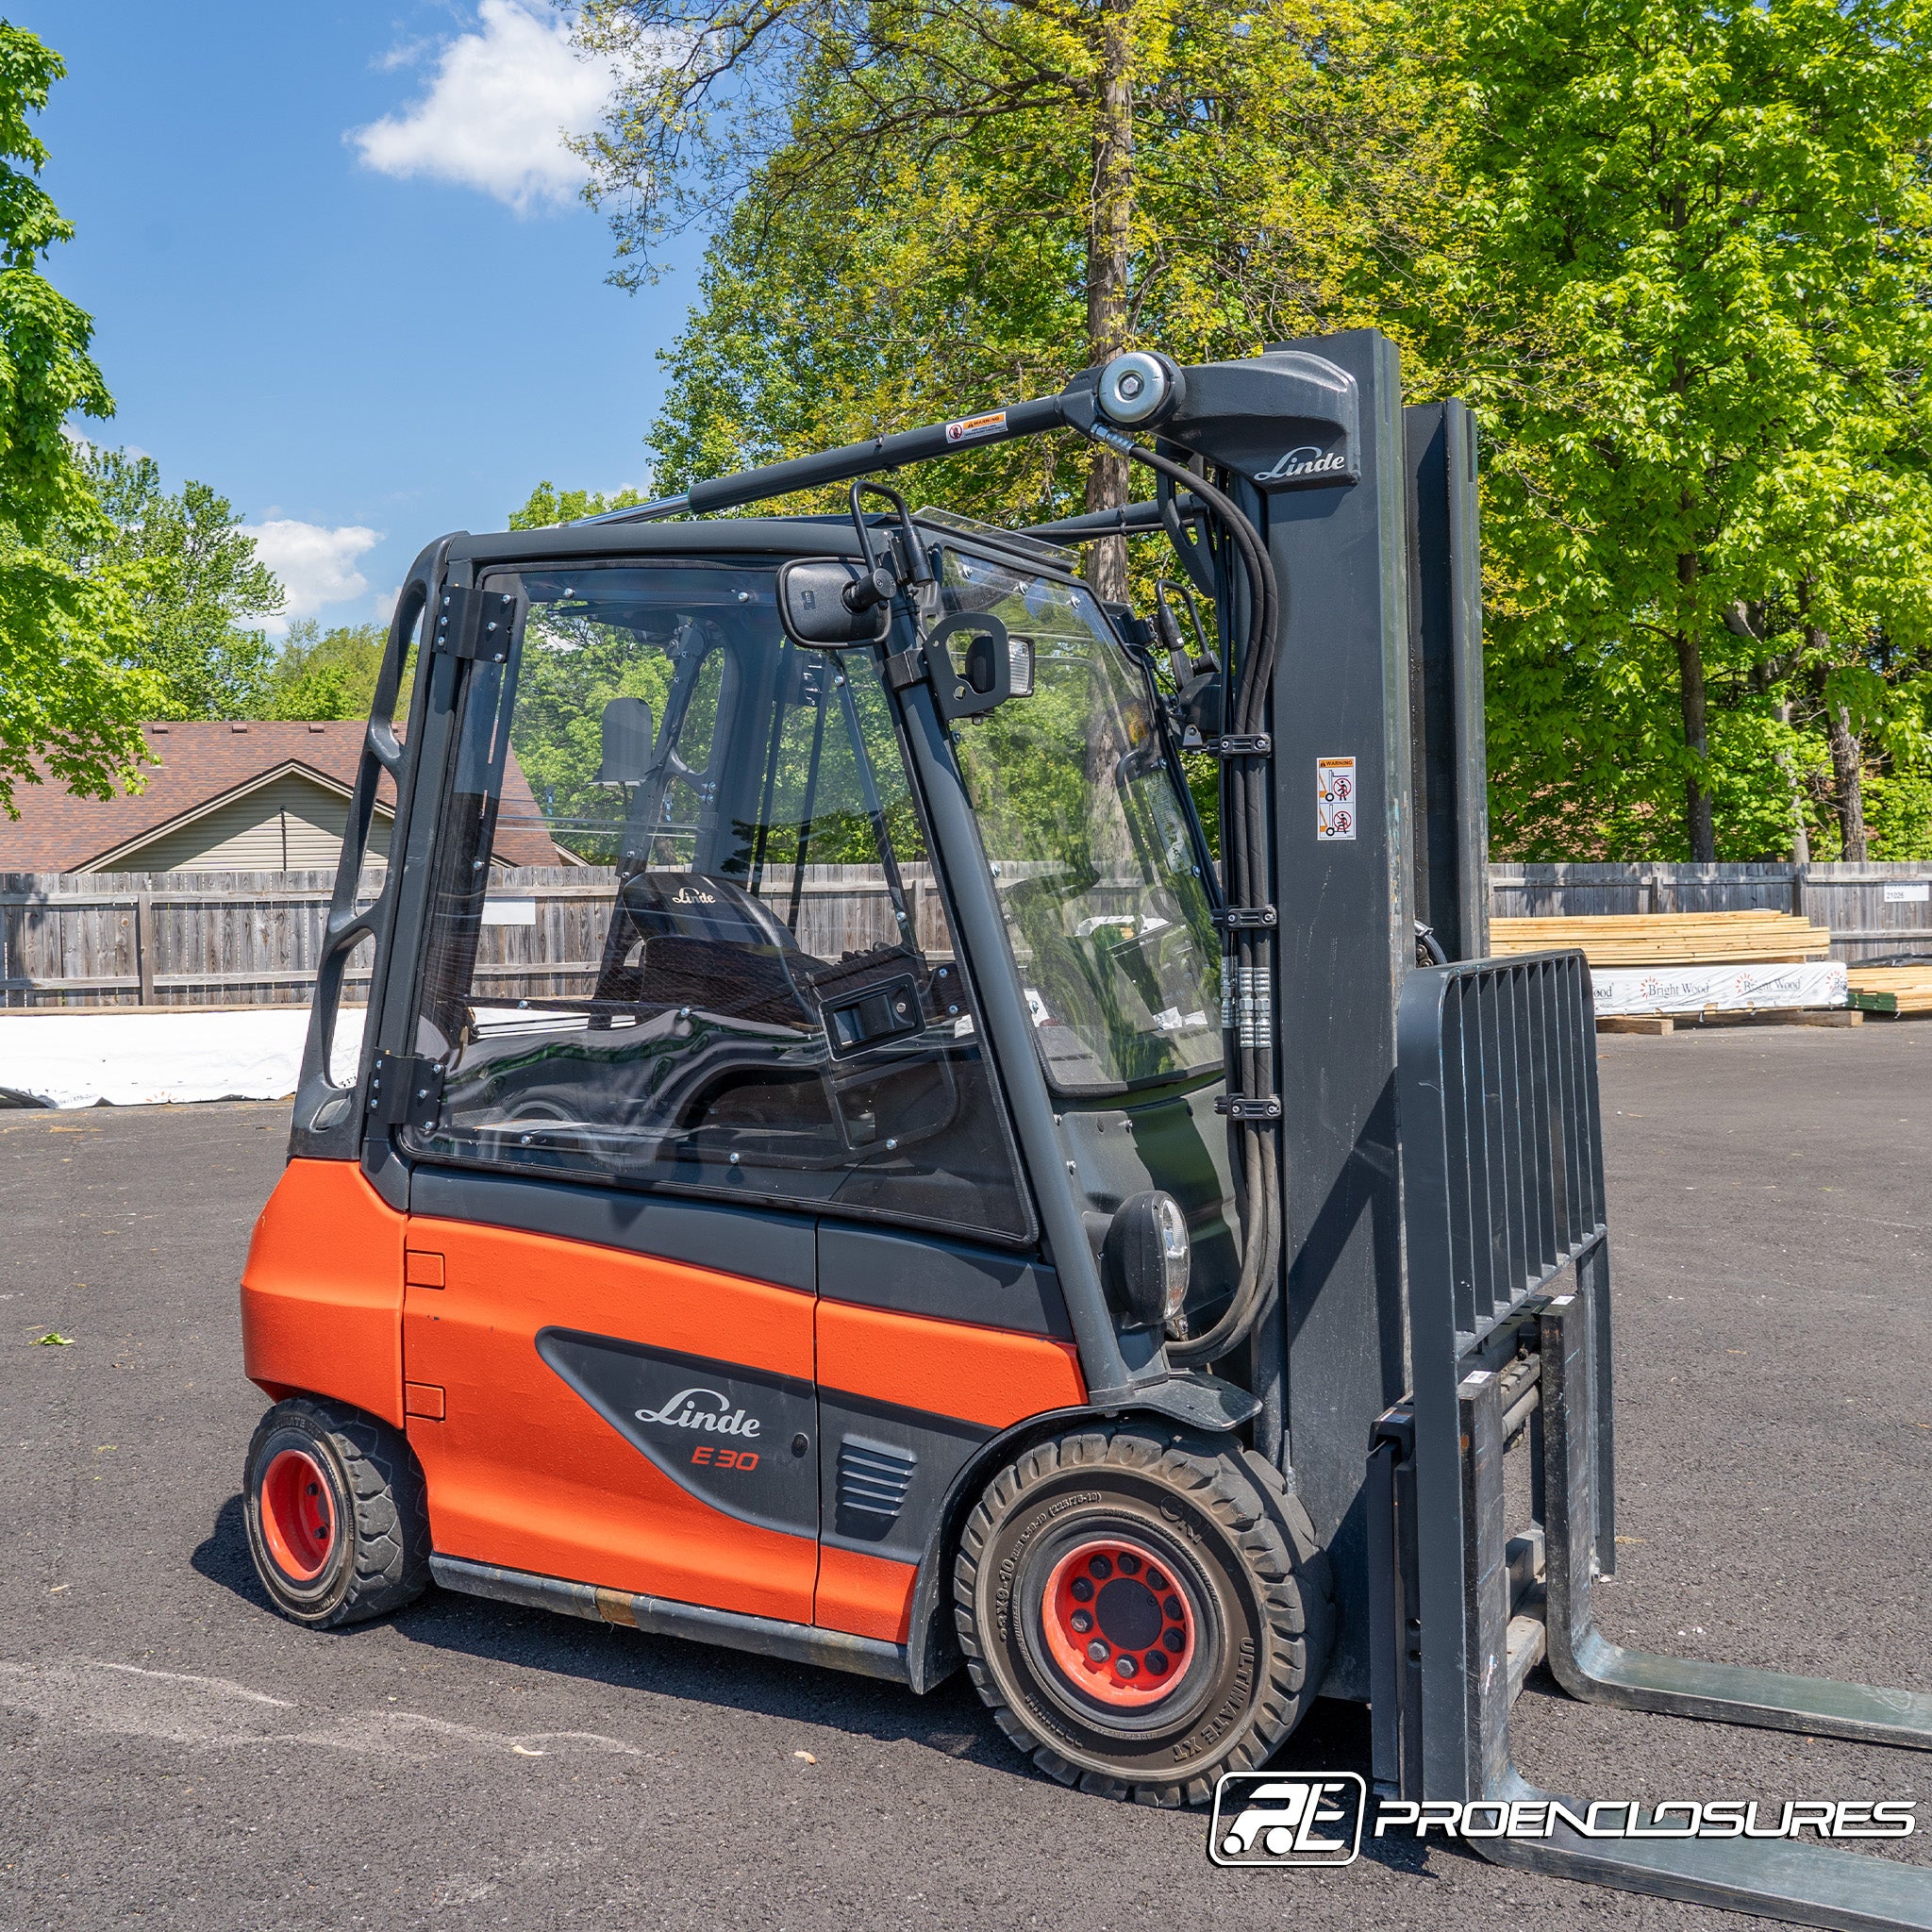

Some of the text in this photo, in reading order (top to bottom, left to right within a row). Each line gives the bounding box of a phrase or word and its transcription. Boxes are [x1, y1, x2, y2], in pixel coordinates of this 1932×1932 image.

[1254, 446, 1345, 481] Linde
[672, 887, 716, 904] Linde
[1648, 982, 1709, 998] Bright Wood
[1774, 978, 1801, 991] Wood
[634, 1388, 760, 1438] Linde
[691, 1446, 760, 1472] E 30
[1201, 1637, 1255, 1745] ULTIMATE
[1172, 1735, 1203, 1763] XT
